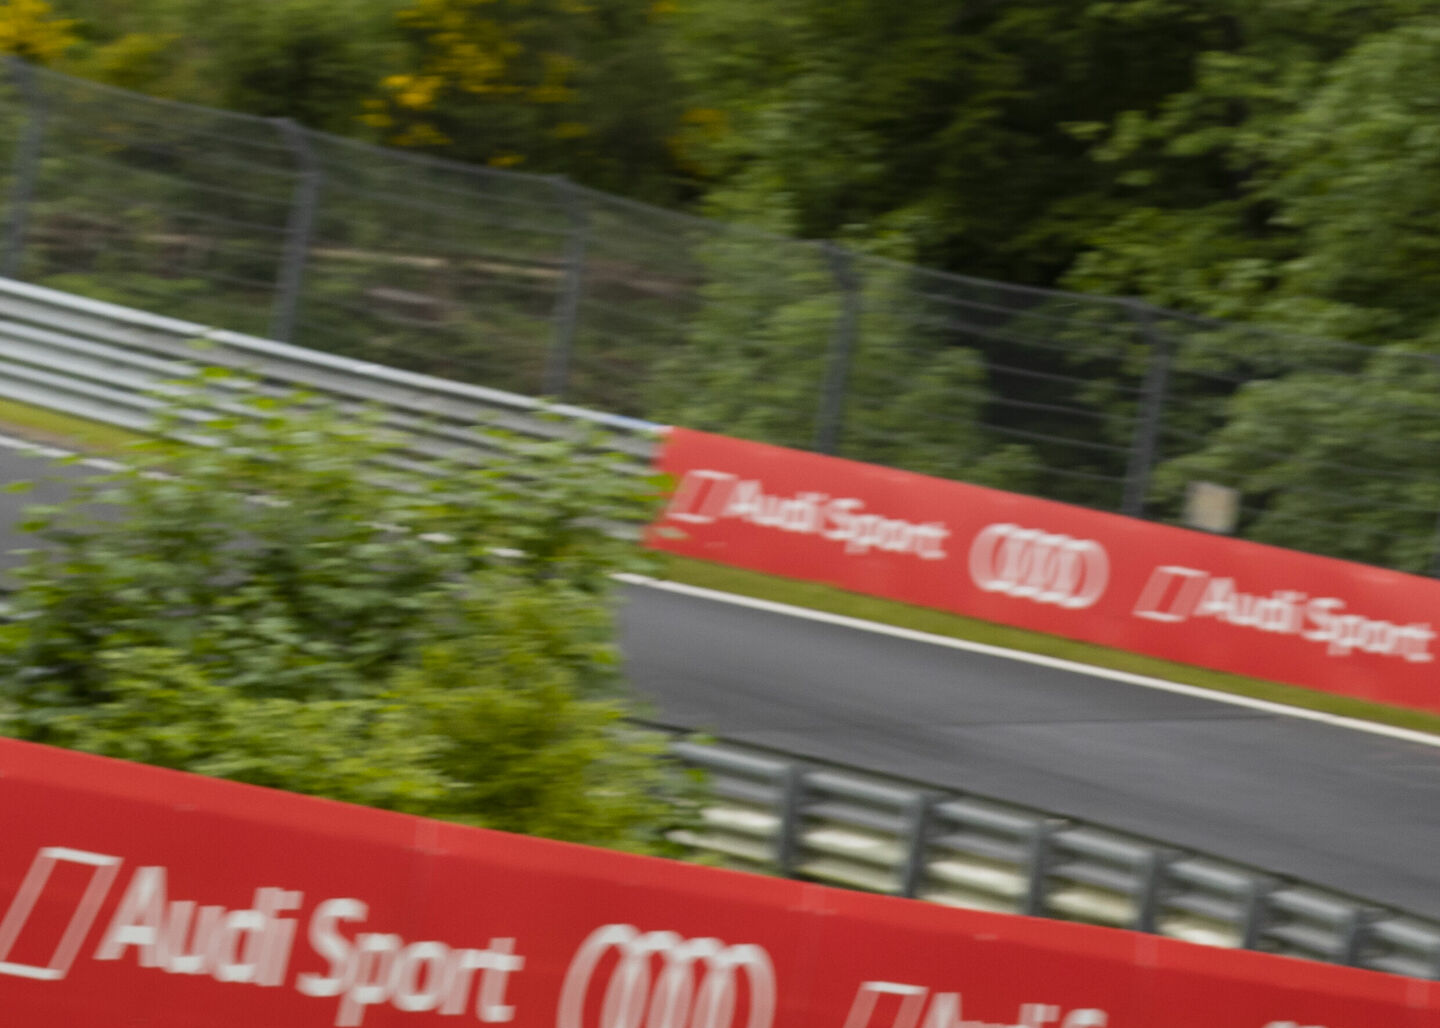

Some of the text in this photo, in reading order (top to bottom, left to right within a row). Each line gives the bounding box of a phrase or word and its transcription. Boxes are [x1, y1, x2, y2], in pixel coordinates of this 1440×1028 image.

[722, 480, 951, 559] Audi Sport
[1194, 578, 1436, 662] Audi Sport
[94, 865, 526, 1027] Audi Sport
